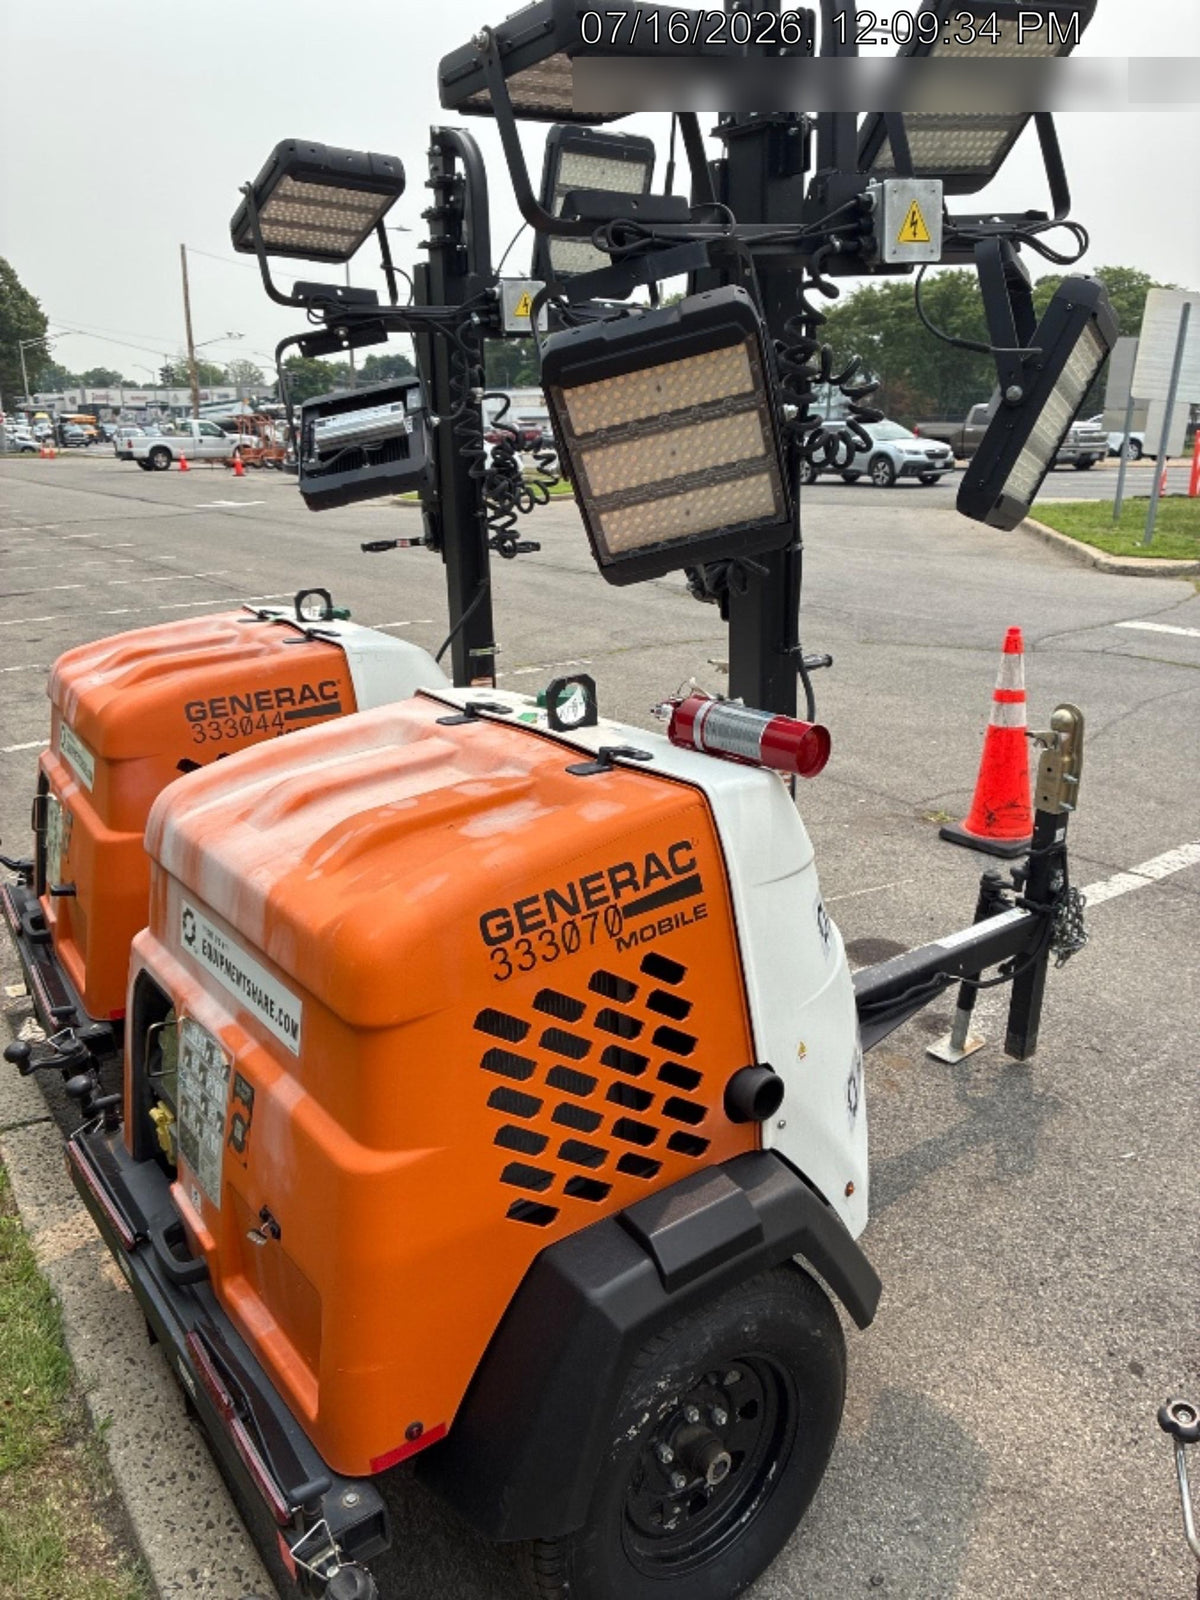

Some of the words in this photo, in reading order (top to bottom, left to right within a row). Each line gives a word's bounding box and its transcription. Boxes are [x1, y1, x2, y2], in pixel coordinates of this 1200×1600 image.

[184, 680, 339, 723] GENERAC
[191, 711, 285, 744] 333044
[479, 840, 698, 947] GENERAC
[490, 903, 624, 982] 333070
[615, 903, 709, 953] MOBILE
